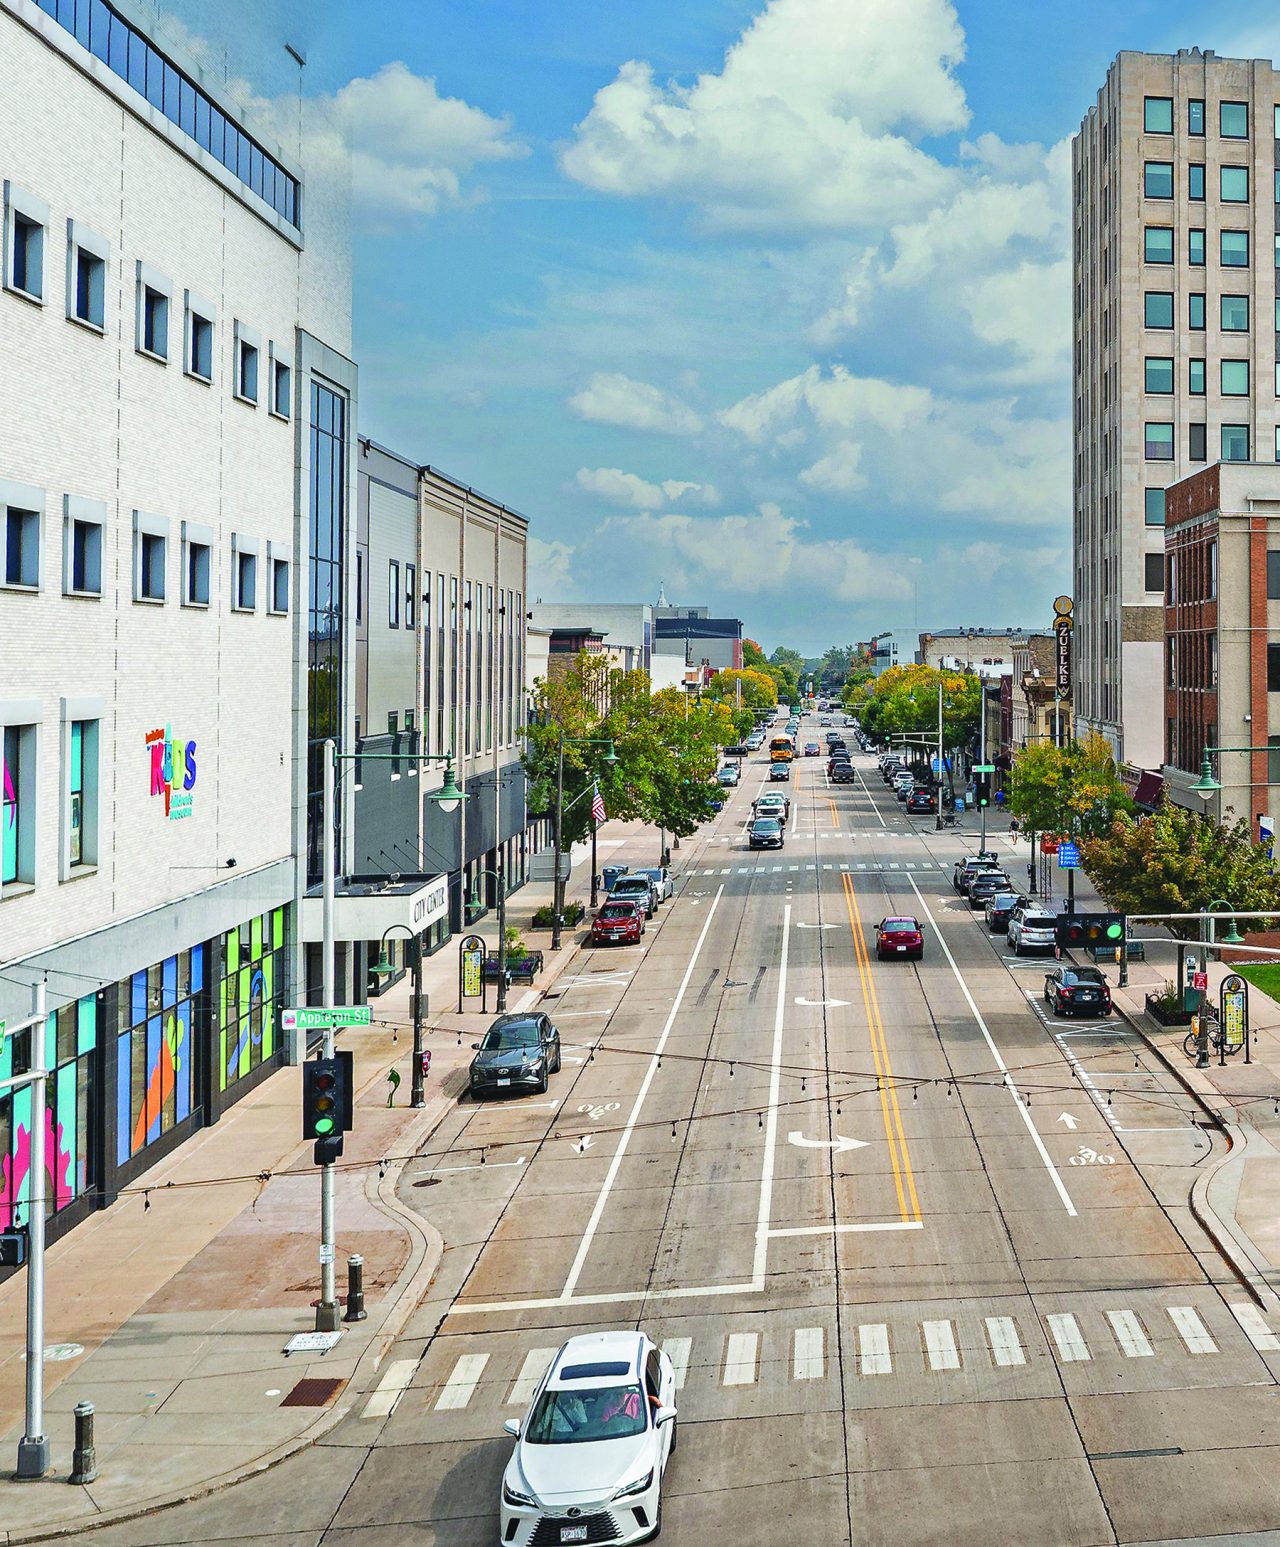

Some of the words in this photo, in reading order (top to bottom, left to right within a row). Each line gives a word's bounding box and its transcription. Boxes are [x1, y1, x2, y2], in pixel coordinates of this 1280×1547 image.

[1059, 627, 1069, 685] ZUELKE
[150, 730, 197, 799] KIDS
[414, 898, 427, 923] CITY
[427, 886, 445, 914] CENTER
[300, 1010, 351, 1026] Appleton
[353, 1008, 367, 1023] St
